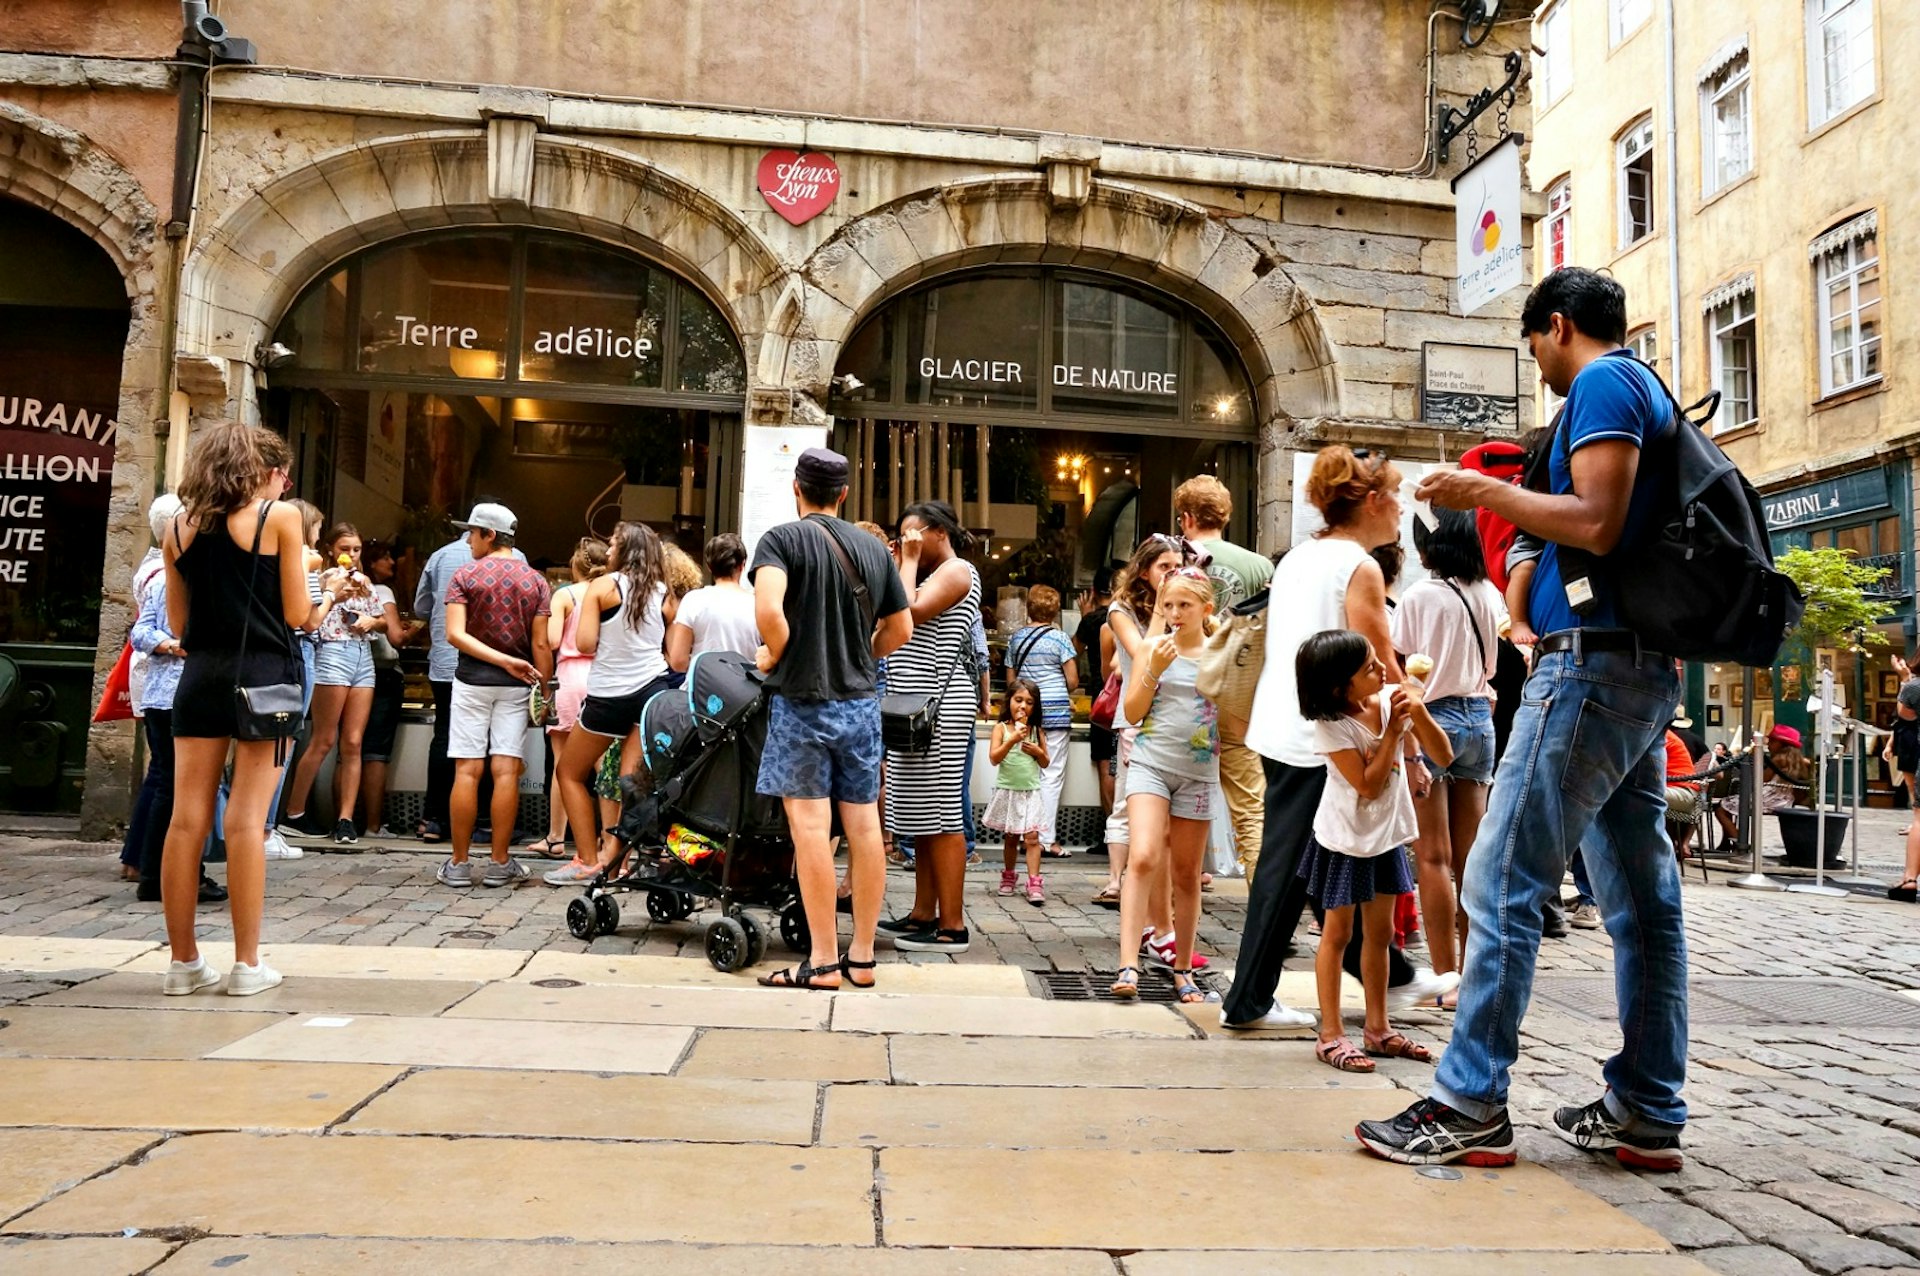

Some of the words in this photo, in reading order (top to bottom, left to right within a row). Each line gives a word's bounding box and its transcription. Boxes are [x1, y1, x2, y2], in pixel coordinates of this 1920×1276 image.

[776, 154, 837, 184] Vieux
[764, 180, 819, 205] Lyon
[395, 315, 478, 350] Terre
[534, 326, 653, 360] adélice
[920, 357, 1022, 383] GLACIER
[1053, 364, 1084, 387] DE
[1092, 368, 1177, 394] NATURE
[1429, 379, 1448, 390] Place
[1460, 381, 1485, 392] Change
[0, 453, 100, 483] LLION
[0, 495, 44, 518] ICE
